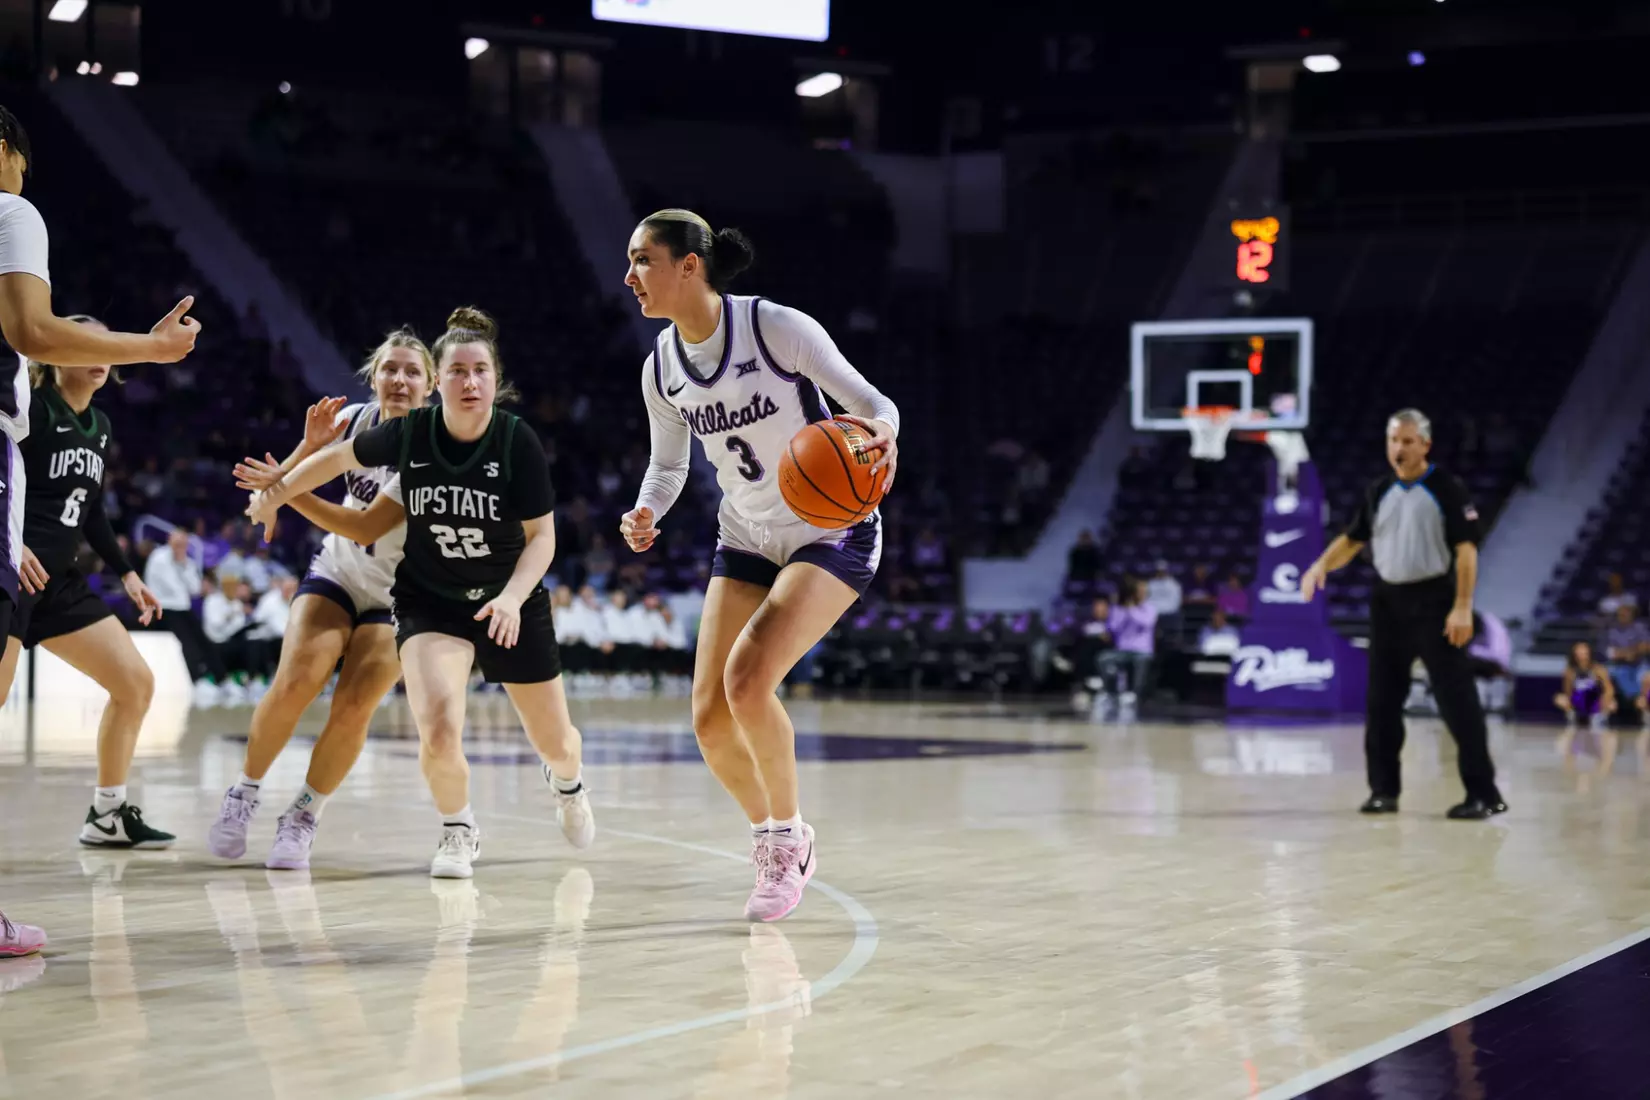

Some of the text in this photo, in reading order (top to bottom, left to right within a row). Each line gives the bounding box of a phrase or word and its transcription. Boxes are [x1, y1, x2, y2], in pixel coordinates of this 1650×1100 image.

[680, 391, 779, 435] Wildcats
[49, 447, 104, 486] UPSTAT
[725, 434, 765, 482] 3
[60, 487, 88, 527] 6
[409, 485, 501, 521] UPSTATE
[429, 523, 491, 559] 22
